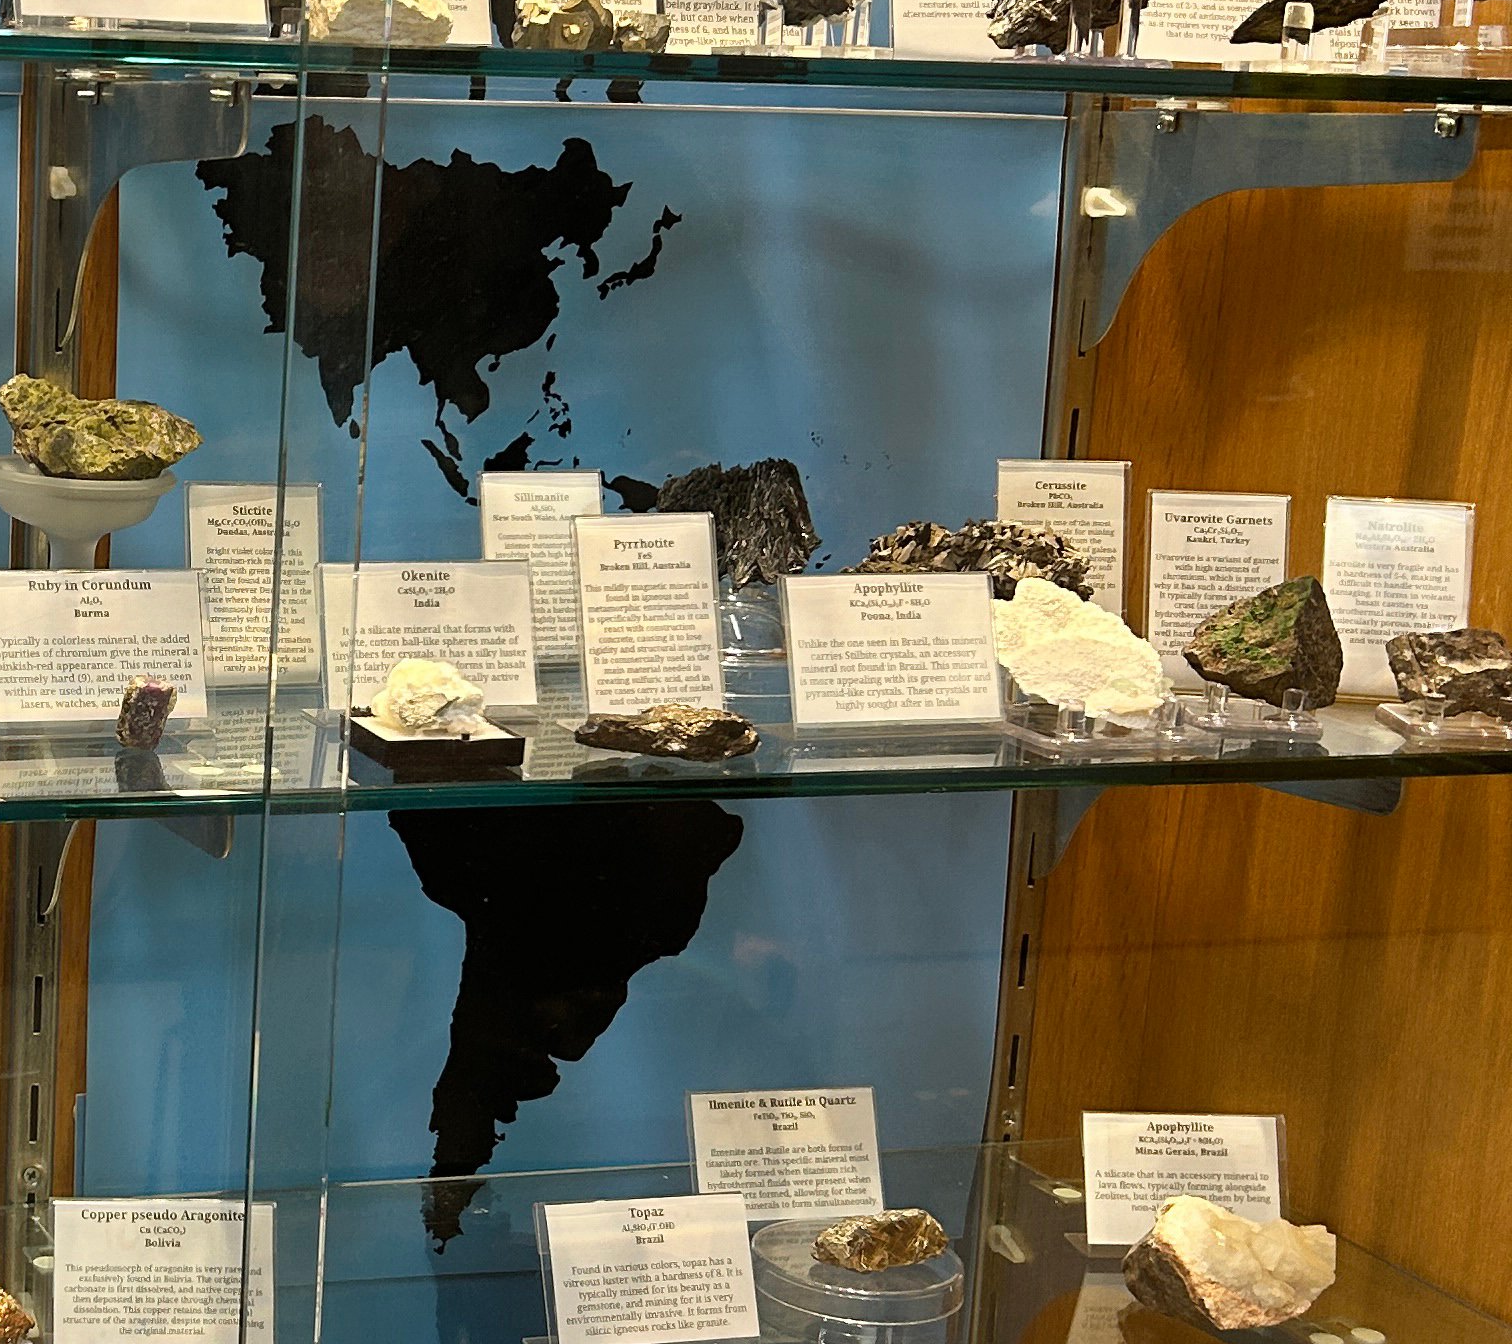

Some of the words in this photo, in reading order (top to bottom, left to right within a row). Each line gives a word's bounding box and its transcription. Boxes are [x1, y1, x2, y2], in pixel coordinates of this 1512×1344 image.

[1035, 480, 1086, 491] Cerussite
[514, 492, 568, 503] Sillimanite
[232, 505, 275, 516] Stictite
[1165, 513, 1223, 524] Uvarovite
[1226, 513, 1272, 525] Garnets
[1367, 521, 1423, 533] Natrolite
[614, 538, 674, 550] Pyrrhotite
[652, 561, 690, 570] Australia
[402, 570, 449, 581] Okenite
[28, 580, 61, 593] Ruby
[64, 579, 78, 591] in
[82, 579, 151, 590] Corundum
[854, 583, 923, 596] Apophyllite
[414, 597, 439, 608] India
[74, 608, 108, 618] Burma
[896, 610, 921, 620] India
[709, 1099, 755, 1111] Ilmenite
[758, 1098, 767, 1109] &
[770, 1097, 802, 1108] Rutile
[804, 1096, 815, 1107] in
[818, 1096, 856, 1108] Quartz
[772, 1122, 798, 1131] Brazil
[1147, 1123, 1213, 1134] Apophyllite
[1200, 1147, 1227, 1157] Brazil
[81, 1210, 126, 1222] Copper
[131, 1210, 176, 1222] pseudo
[181, 1210, 246, 1223] Aragonite
[628, 1206, 664, 1220] Topaz
[145, 1238, 180, 1248] Bolivia
[636, 1234, 664, 1245] Brazil
